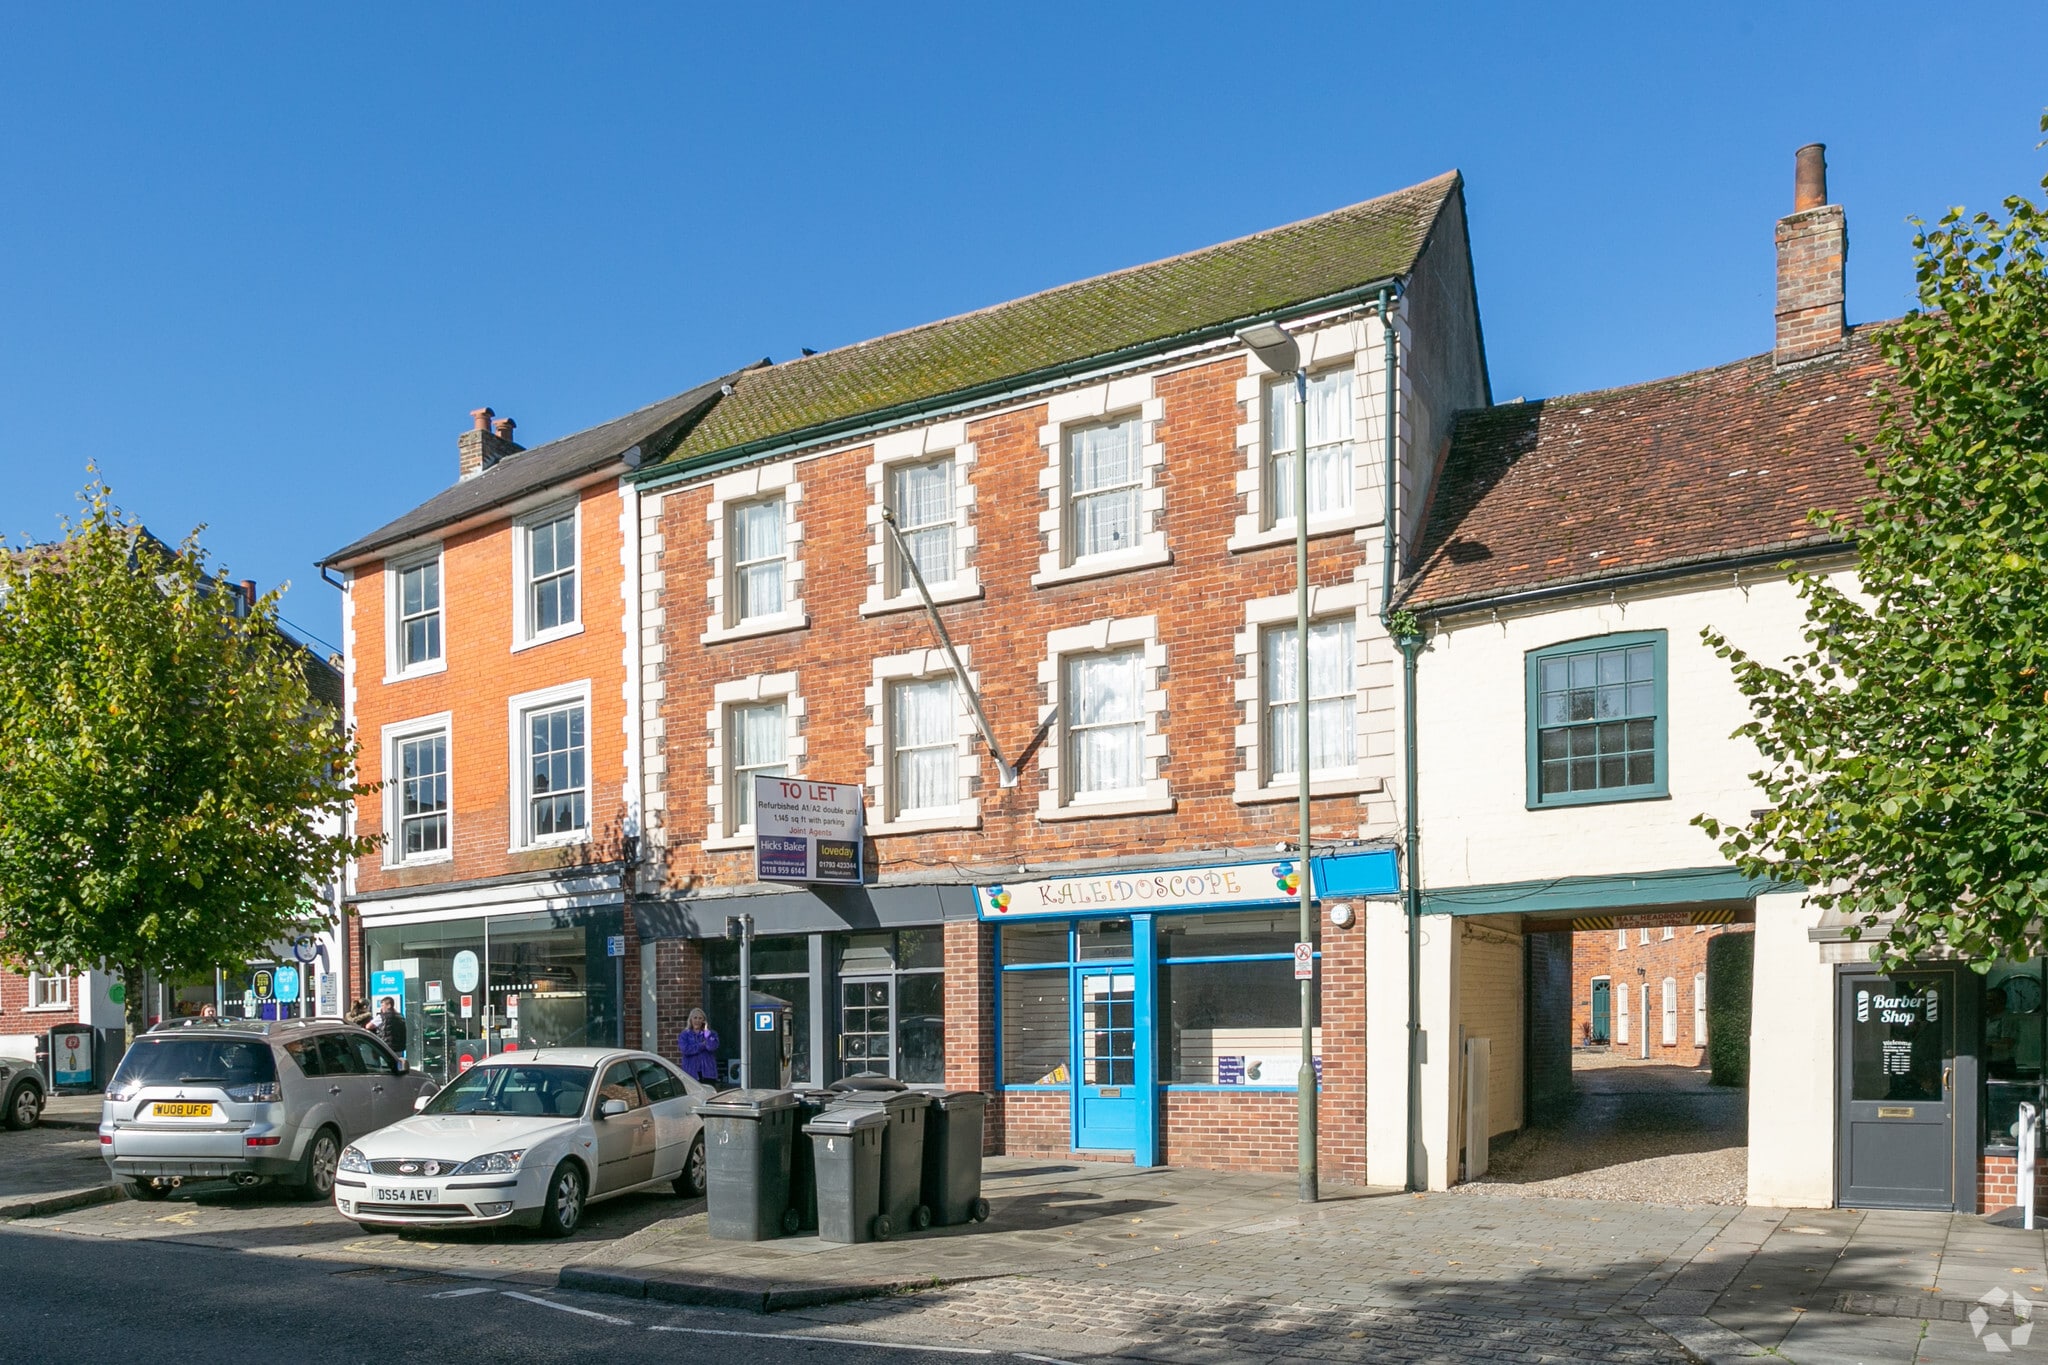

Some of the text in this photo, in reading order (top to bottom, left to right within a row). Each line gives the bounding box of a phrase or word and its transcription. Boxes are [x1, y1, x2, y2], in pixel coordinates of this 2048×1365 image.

[780, 782, 837, 802] TO LET
[758, 801, 799, 811] Refurbished
[823, 805, 844, 814] double
[845, 808, 858, 816] unit
[823, 818, 845, 827] parking
[809, 828, 832, 837] Agents
[760, 840, 806, 852] Hicks Baker
[821, 844, 854, 859] loveday
[761, 866, 805, 874] 0118 959 6144
[1038, 869, 1241, 906] KALEIDOSCOPE
[1640, 911, 1688, 921] HEADROOM
[1872, 994, 1925, 1009] Barber
[760, 1015, 771, 1028] P
[1880, 1009, 1916, 1026] Shop
[156, 1103, 208, 1115] WU08 UFG
[378, 1189, 433, 1201] DS54 AEV
